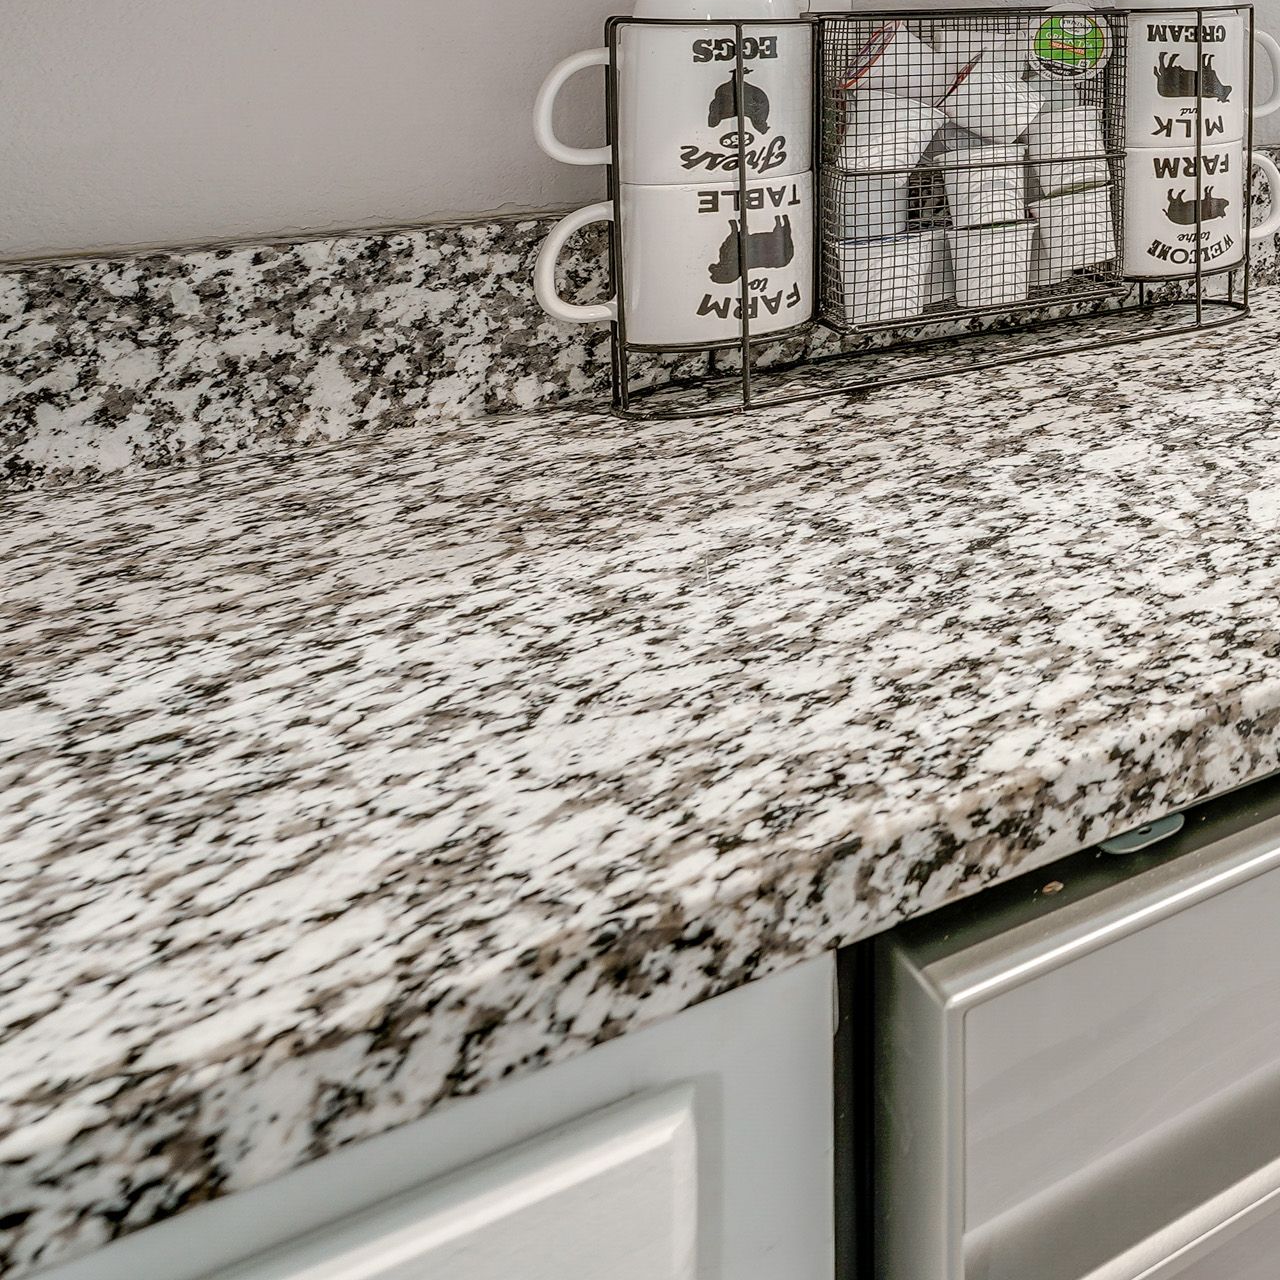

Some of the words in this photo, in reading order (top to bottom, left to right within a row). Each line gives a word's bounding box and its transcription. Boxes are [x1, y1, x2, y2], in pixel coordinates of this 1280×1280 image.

[1147, 24, 1226, 42] CREAM
[692, 36, 778, 62] EGGS
[1151, 115, 1224, 138] MLK
[680, 135, 787, 174] Fresh
[1153, 153, 1229, 178] FARM
[698, 184, 800, 213] TABLE
[1146, 234, 1234, 265] WELCOME
[747, 277, 768, 293] to
[696, 282, 801, 319] FARM
